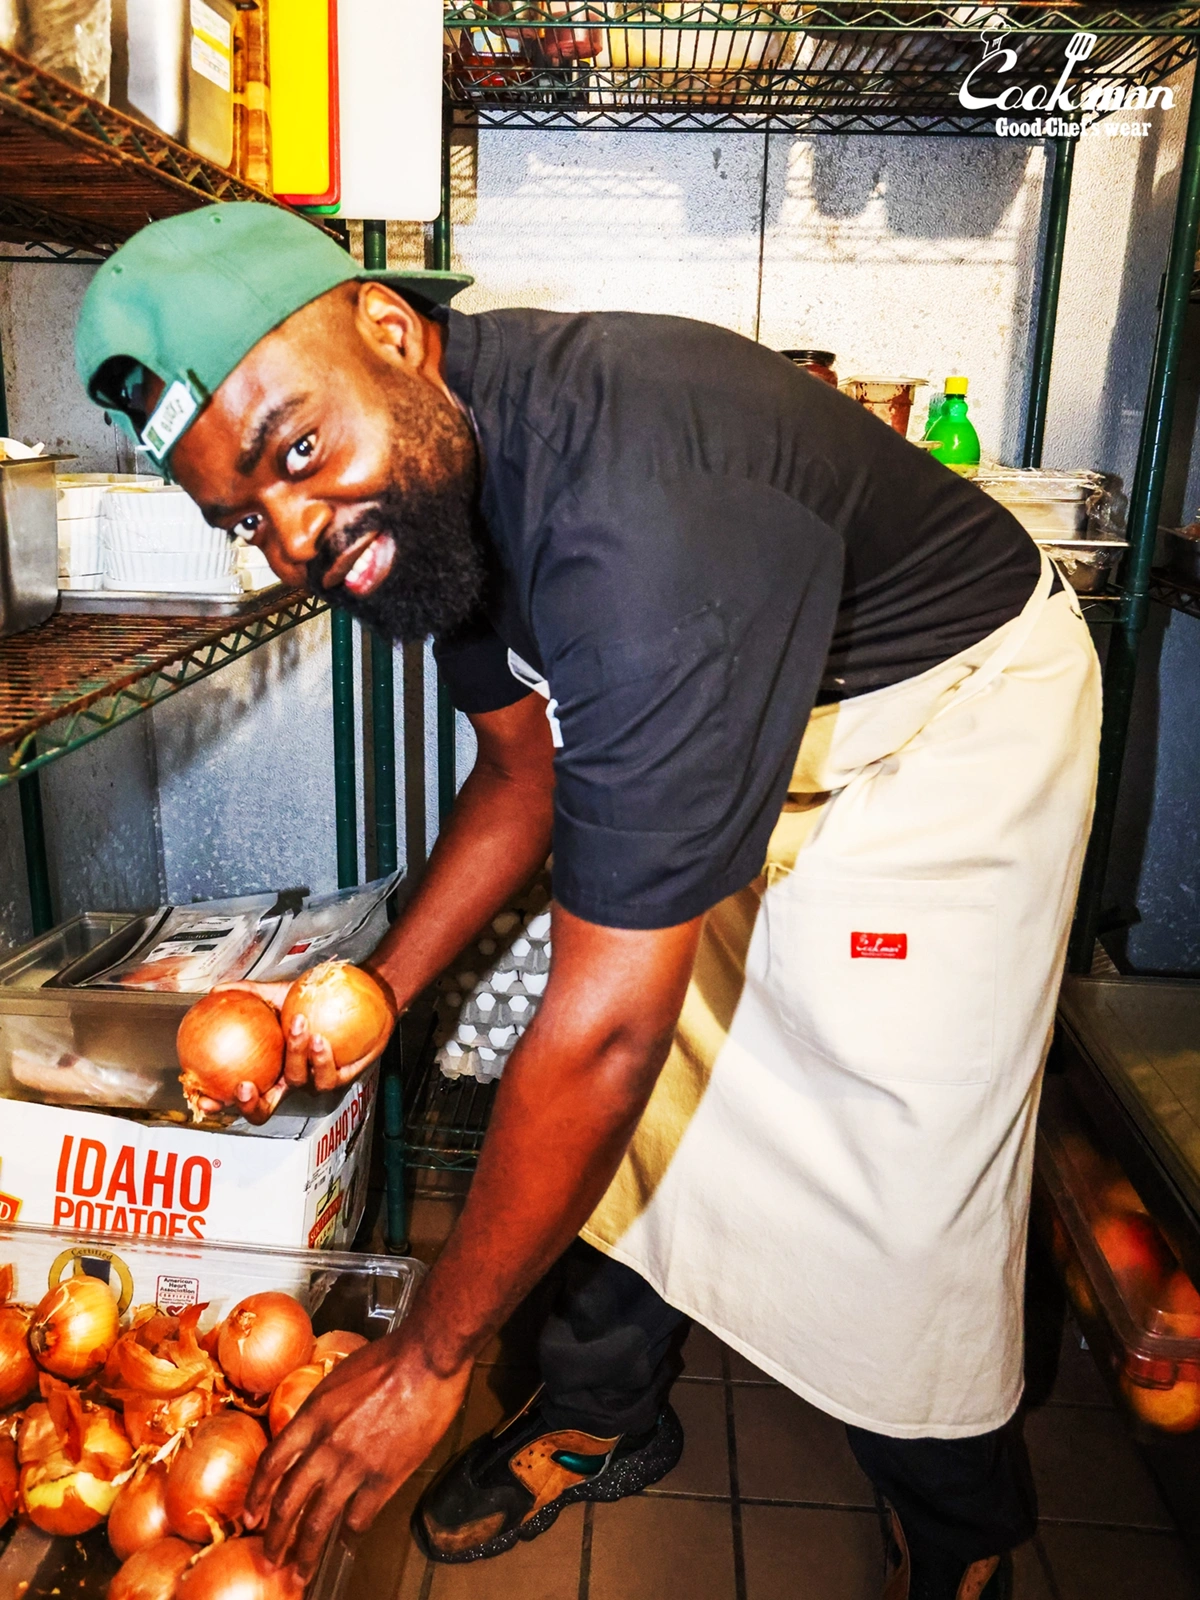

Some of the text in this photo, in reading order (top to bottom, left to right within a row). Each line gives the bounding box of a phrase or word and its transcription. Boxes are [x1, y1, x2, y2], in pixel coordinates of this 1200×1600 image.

[315, 1109, 350, 1167] IDAHO
[53, 1196, 206, 1240] POTATOES
[71, 1248, 113, 1260] Certified
